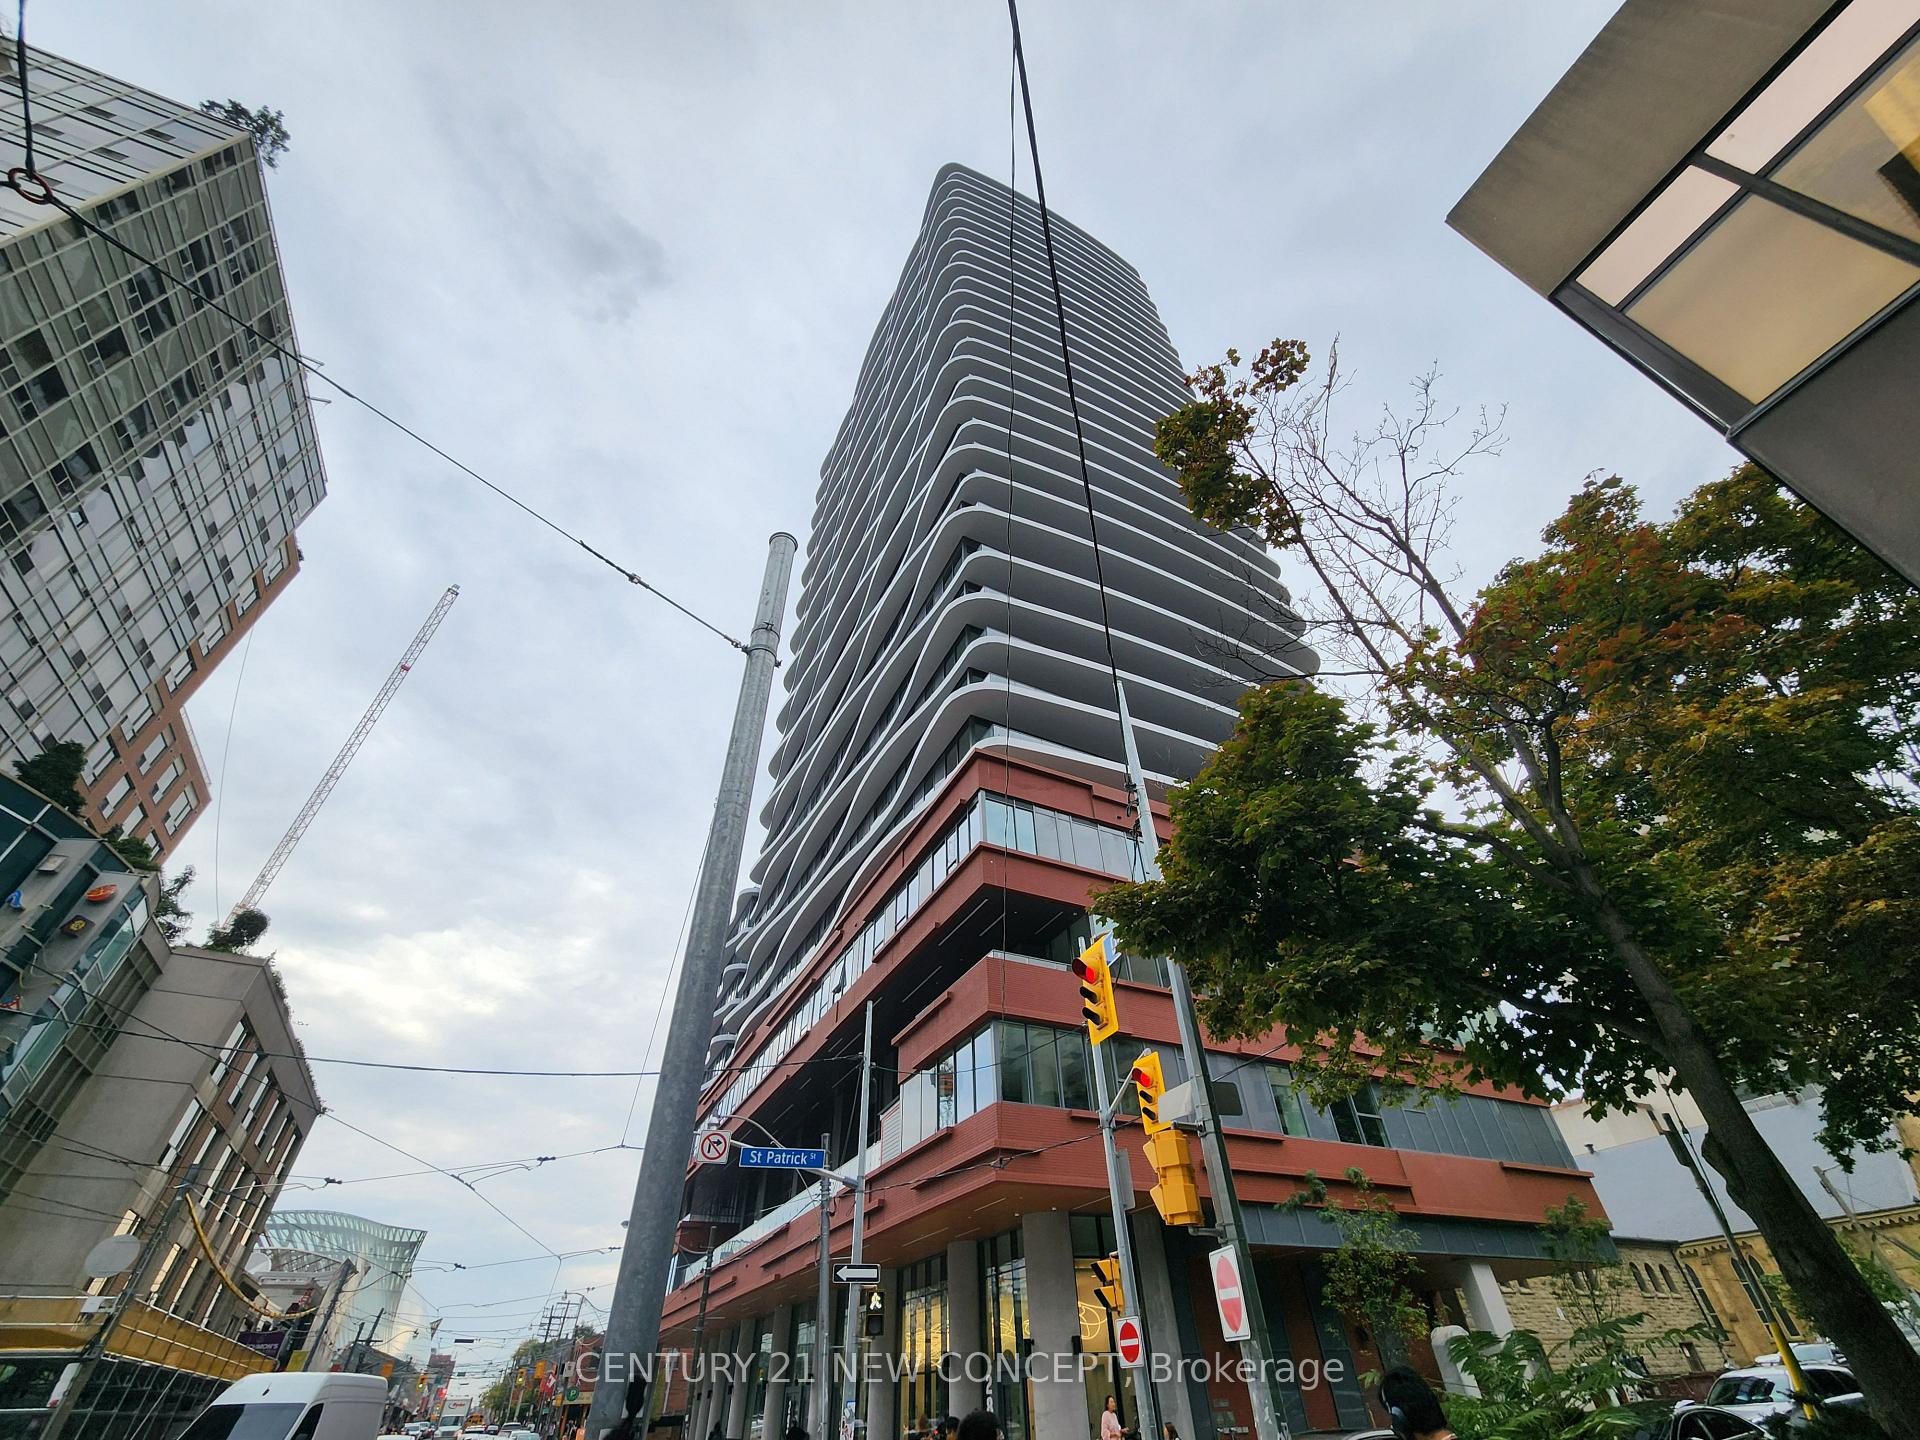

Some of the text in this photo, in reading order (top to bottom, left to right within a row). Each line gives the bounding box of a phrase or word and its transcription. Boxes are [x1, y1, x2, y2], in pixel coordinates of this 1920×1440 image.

[750, 1150, 817, 1165] St Patrick St
